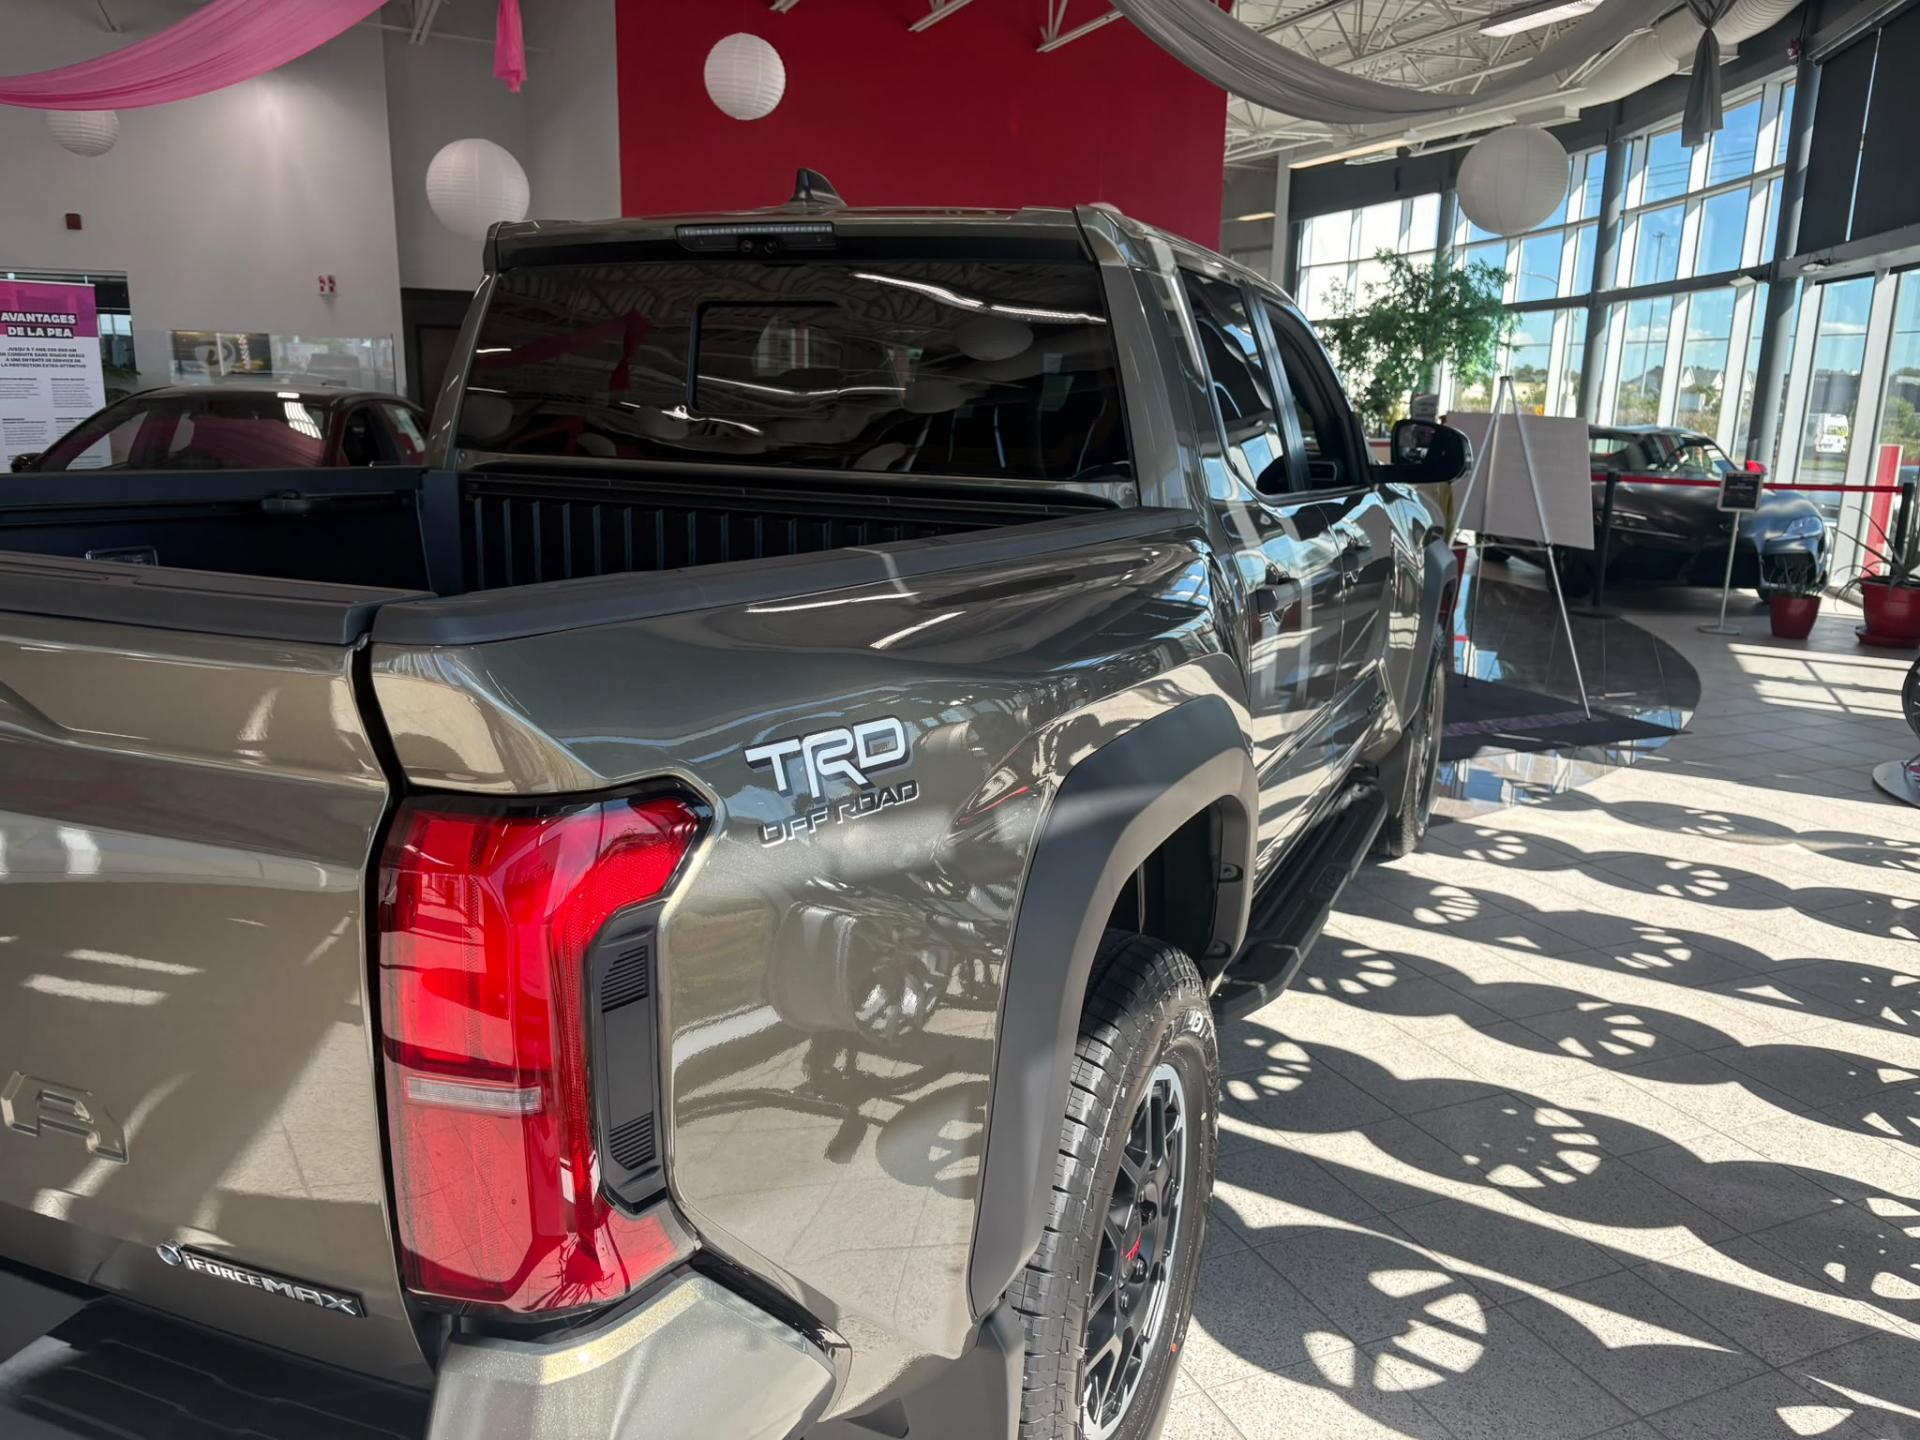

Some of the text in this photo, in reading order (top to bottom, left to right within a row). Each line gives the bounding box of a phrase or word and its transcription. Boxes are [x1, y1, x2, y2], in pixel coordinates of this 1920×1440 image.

[1, 312, 76, 324] AVANTAGES
[7, 327, 72, 337] DE LA PEA
[744, 716, 909, 801] TRD
[759, 780, 920, 848] OFF ROAD
[260, 1276, 356, 1316] MAX
